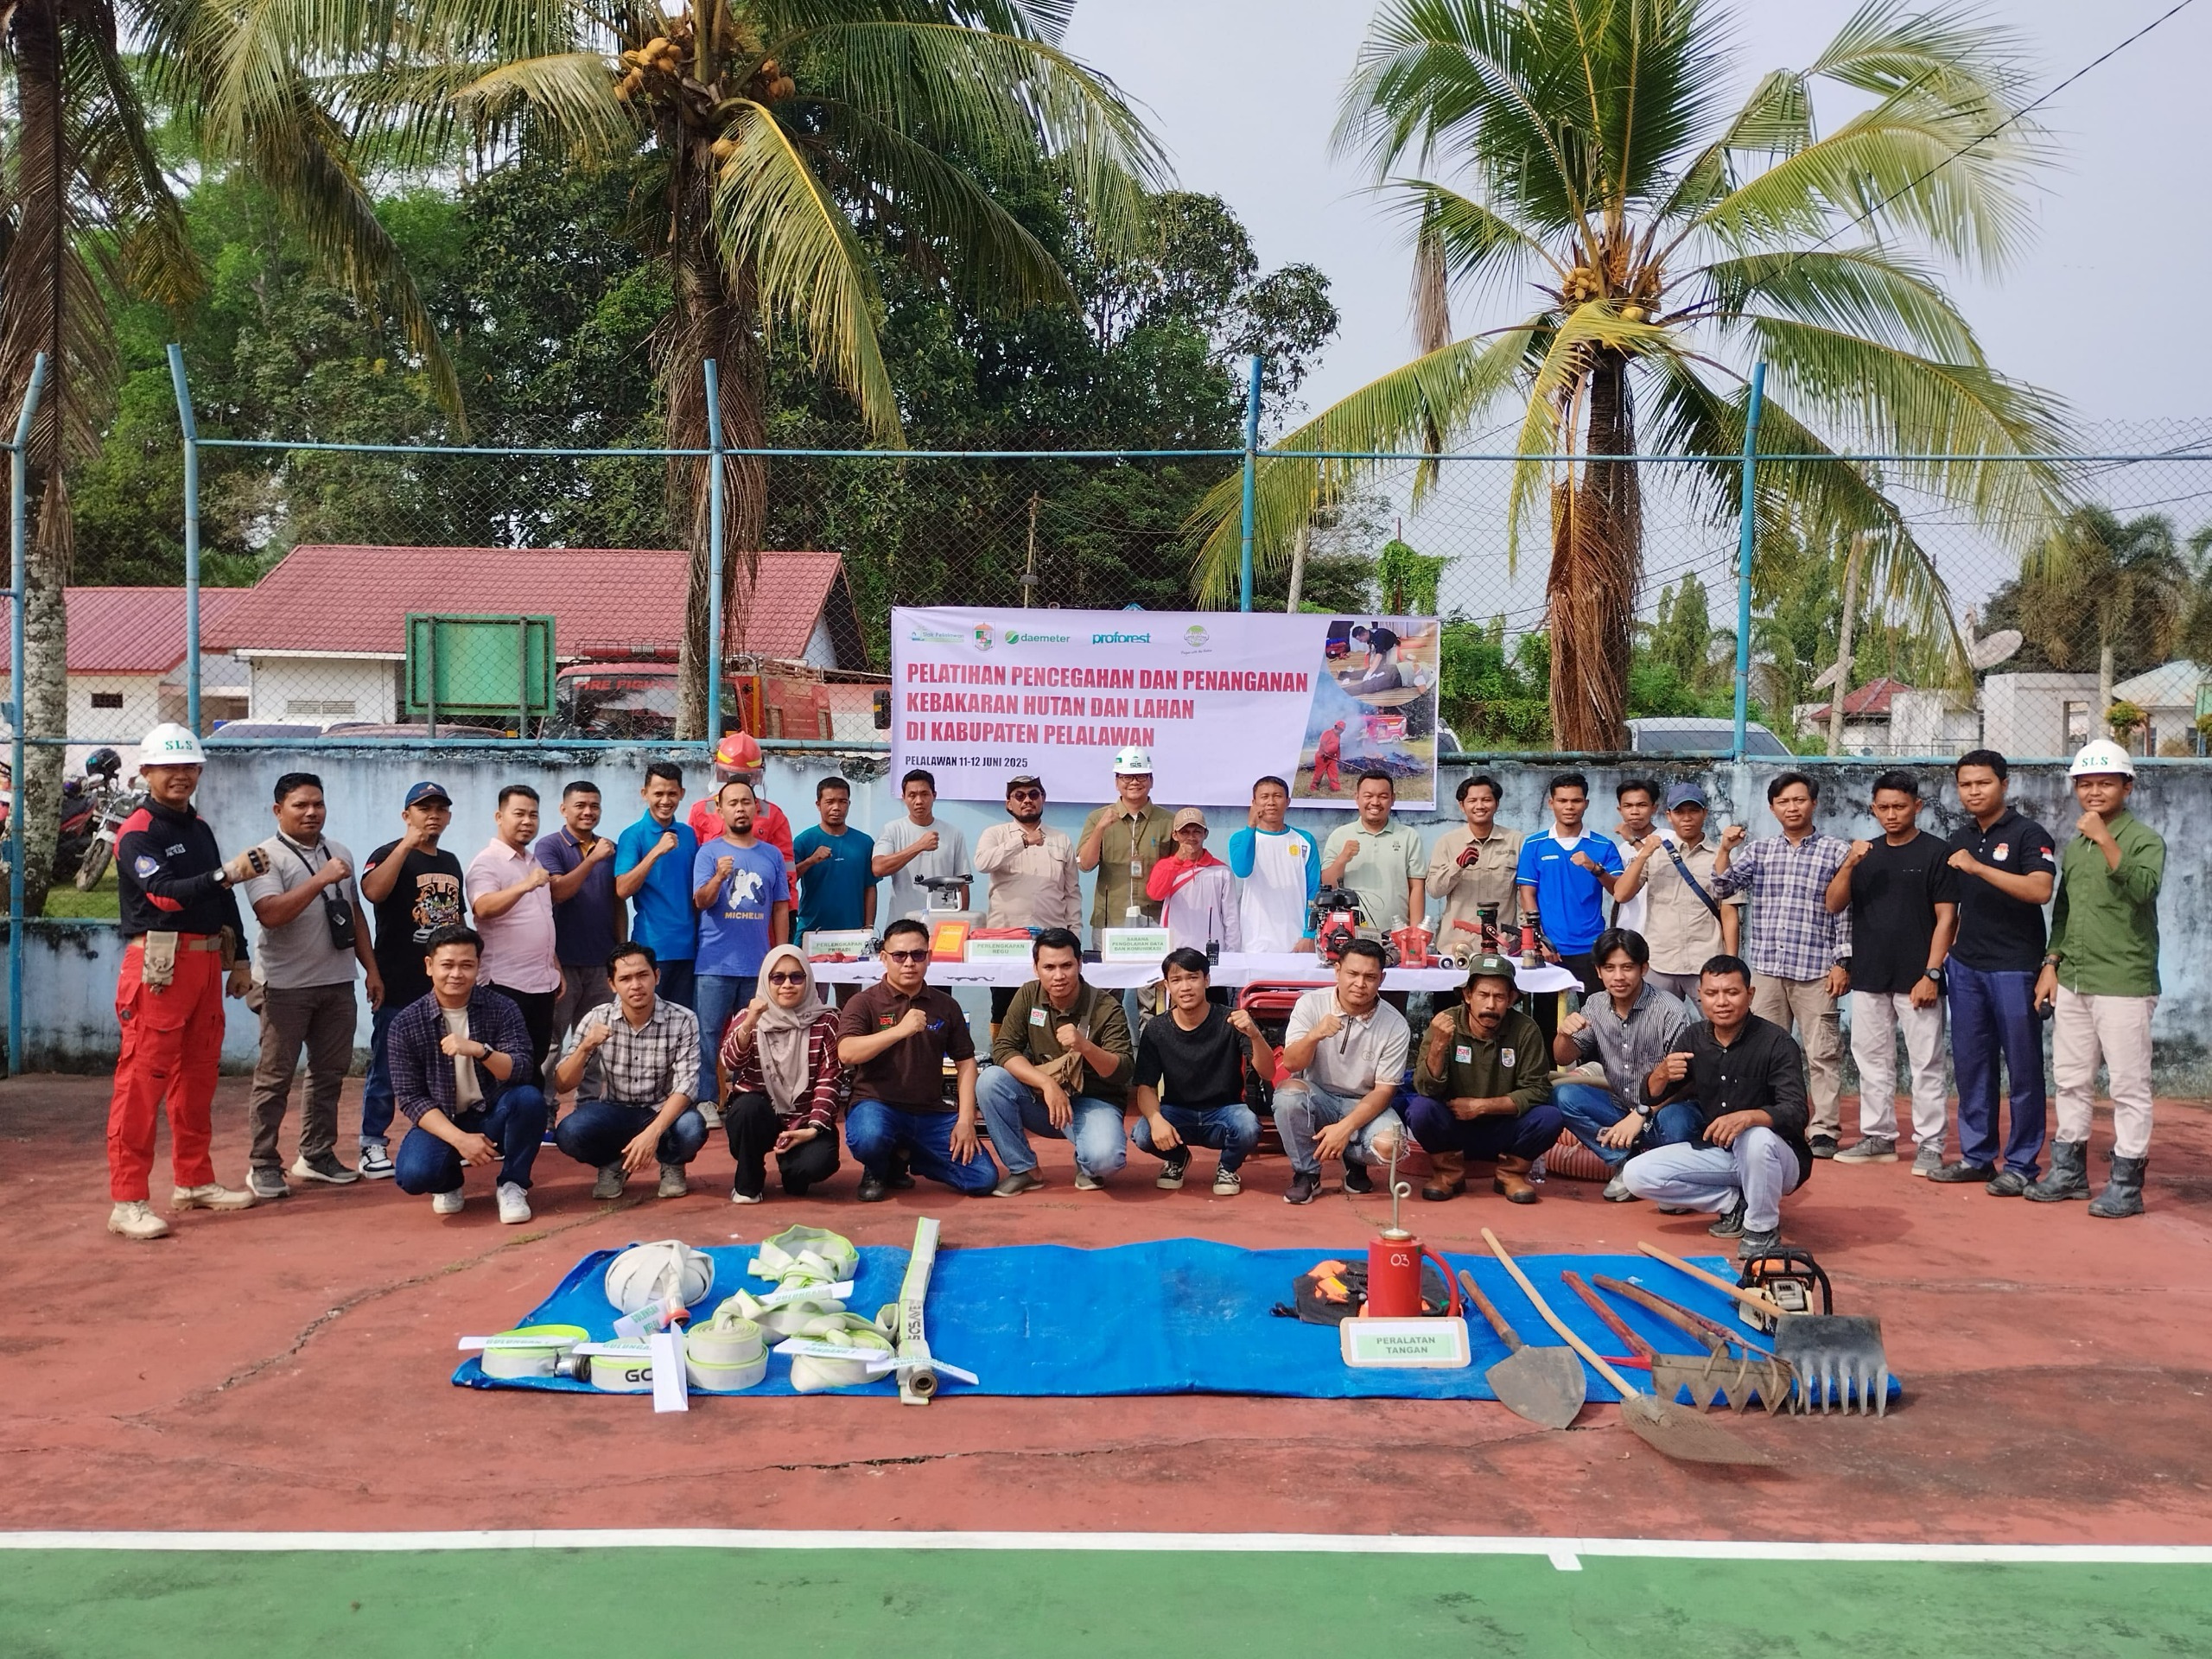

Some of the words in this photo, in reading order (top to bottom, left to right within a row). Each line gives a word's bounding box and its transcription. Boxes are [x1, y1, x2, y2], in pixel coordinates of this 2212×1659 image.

[1020, 632, 1071, 643] daemeter
[1092, 632, 1151, 645] proforest
[907, 663, 1006, 685] PELATIHAN
[1011, 666, 1135, 690] PENCEGAHAN
[1140, 669, 1178, 690] DAN
[1183, 671, 1308, 693] PENANGANAN
[575, 679, 611, 690] FIRE
[616, 679, 678, 690] FIGHTE
[907, 692, 1018, 714] KEBAKARAN
[1023, 696, 1084, 716] HUTAN
[1090, 697, 1128, 718] DAN
[1134, 698, 1194, 720] LAHAN
[906, 721, 925, 741] DI
[931, 721, 1039, 743] KABUPATEN
[1044, 725, 1154, 747] PELALAWAN
[165, 740, 193, 750] SLS
[906, 755, 957, 767] PELALAWAN
[959, 757, 981, 767] 11-12
[982, 757, 1001, 767] JUNI
[1004, 757, 1028, 768] 2025
[2082, 756, 2108, 767] SLS
[724, 912, 765, 920] MICHELIN
[1390, 1253, 1410, 1267] 03
[1376, 1336, 1436, 1344] PERALATAN
[1386, 1345, 1428, 1354] TANGAN
